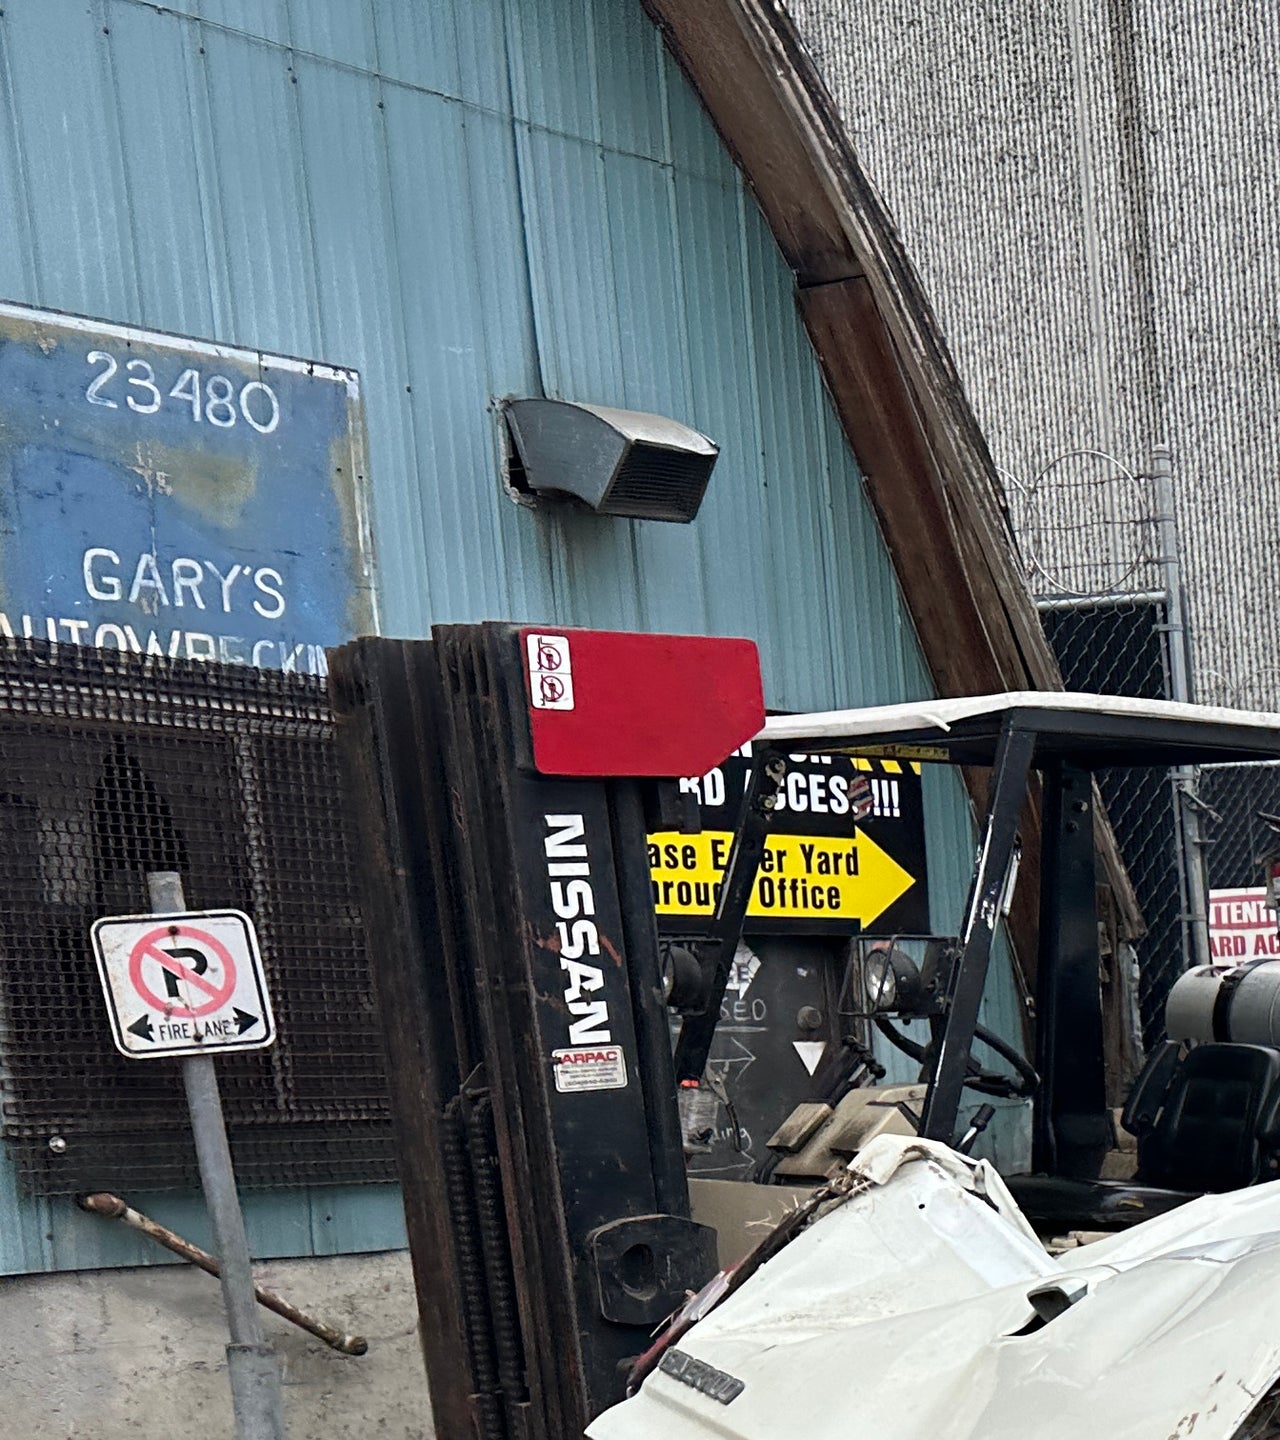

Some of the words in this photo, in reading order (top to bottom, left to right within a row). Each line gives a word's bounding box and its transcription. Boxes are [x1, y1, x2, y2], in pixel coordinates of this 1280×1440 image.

[86, 350, 279, 434] 23480
[82, 547, 285, 619] GARY'S
[711, 839, 787, 873] Eer
[799, 844, 859, 876] Yard
[758, 876, 841, 910] Office
[545, 813, 611, 1046] NISSAN
[159, 1023, 190, 1041] FIRE
[561, 1051, 618, 1065] ARPAC
